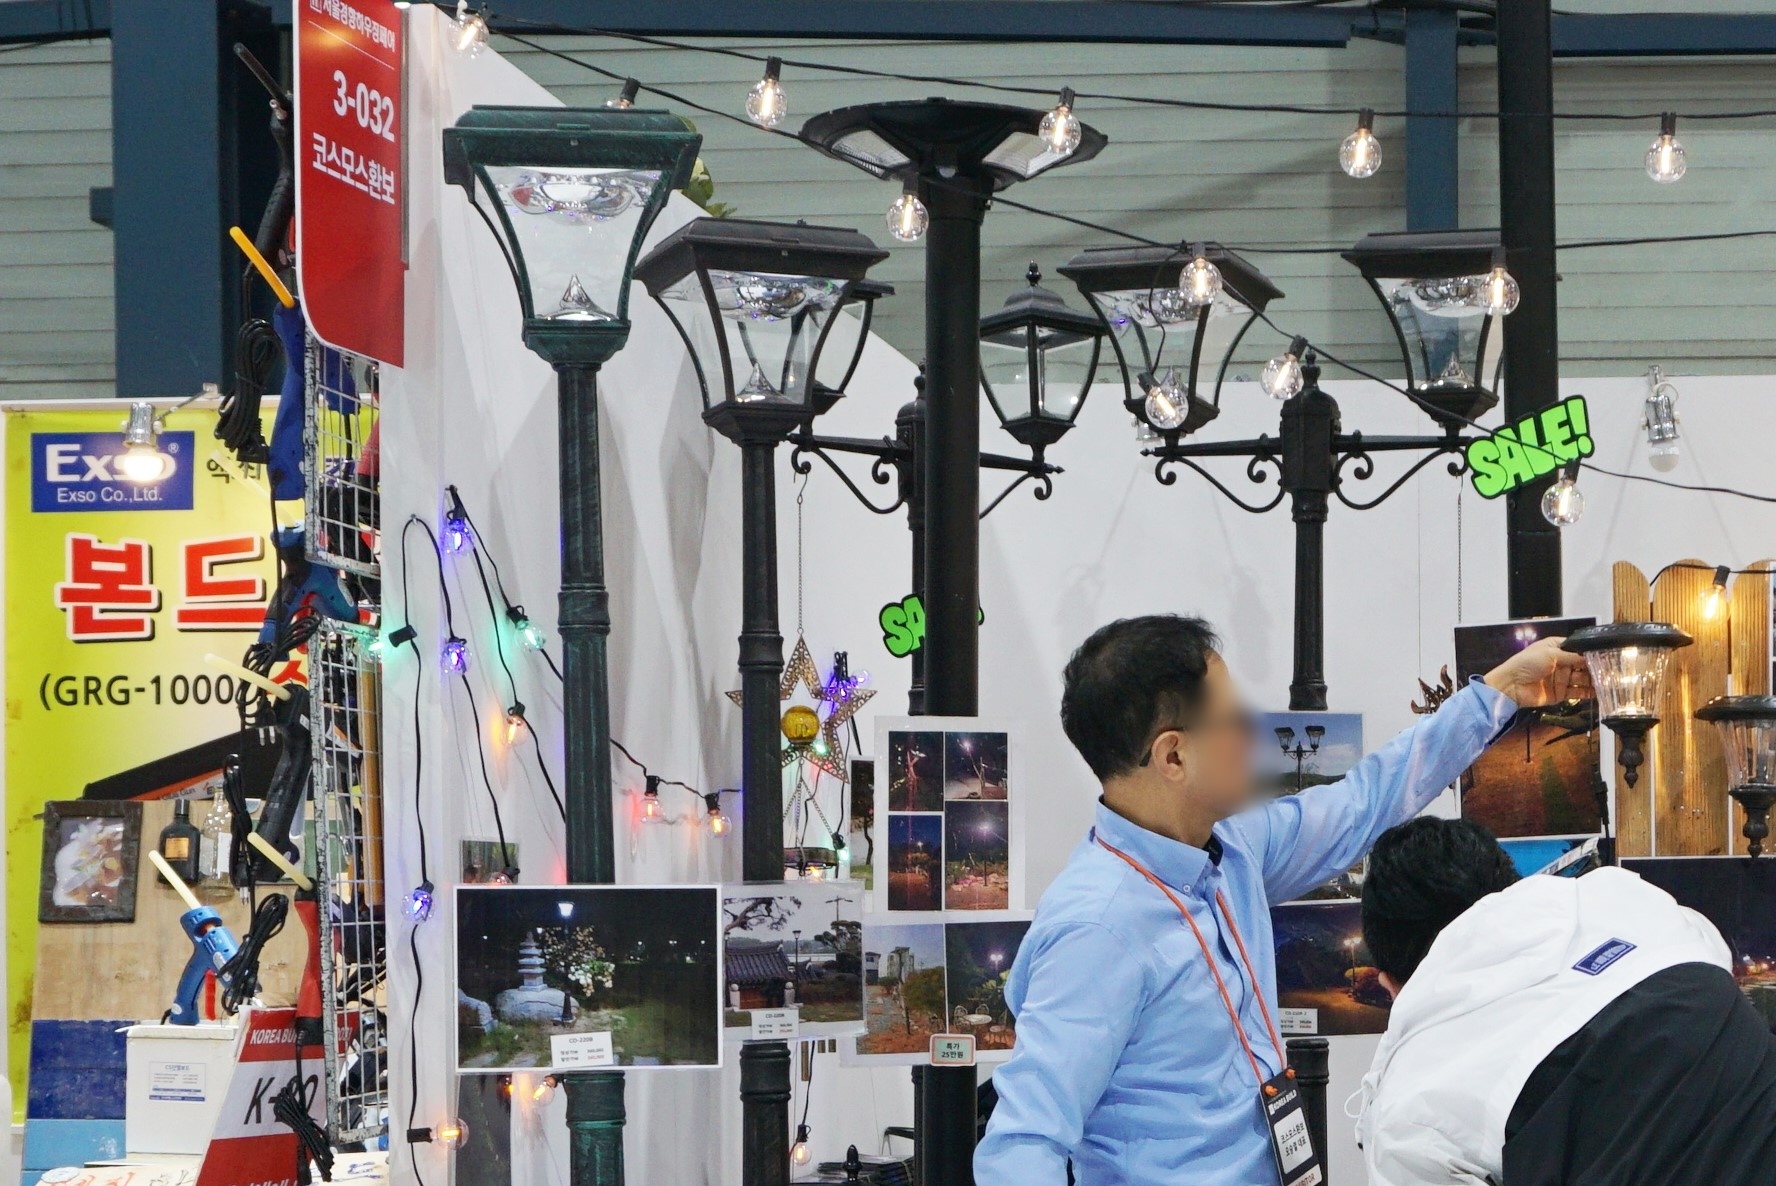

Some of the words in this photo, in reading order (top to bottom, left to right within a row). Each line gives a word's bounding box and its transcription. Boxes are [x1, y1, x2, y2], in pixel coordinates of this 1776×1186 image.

[332, 69, 396, 143] 3-032
[312, 131, 396, 206] 코스모스환보
[1467, 395, 1594, 499] SALE!
[57, 488, 96, 503] Exso
[101, 486, 163, 505] Co.,Ltd.
[250, 1028, 282, 1045] KOREA
